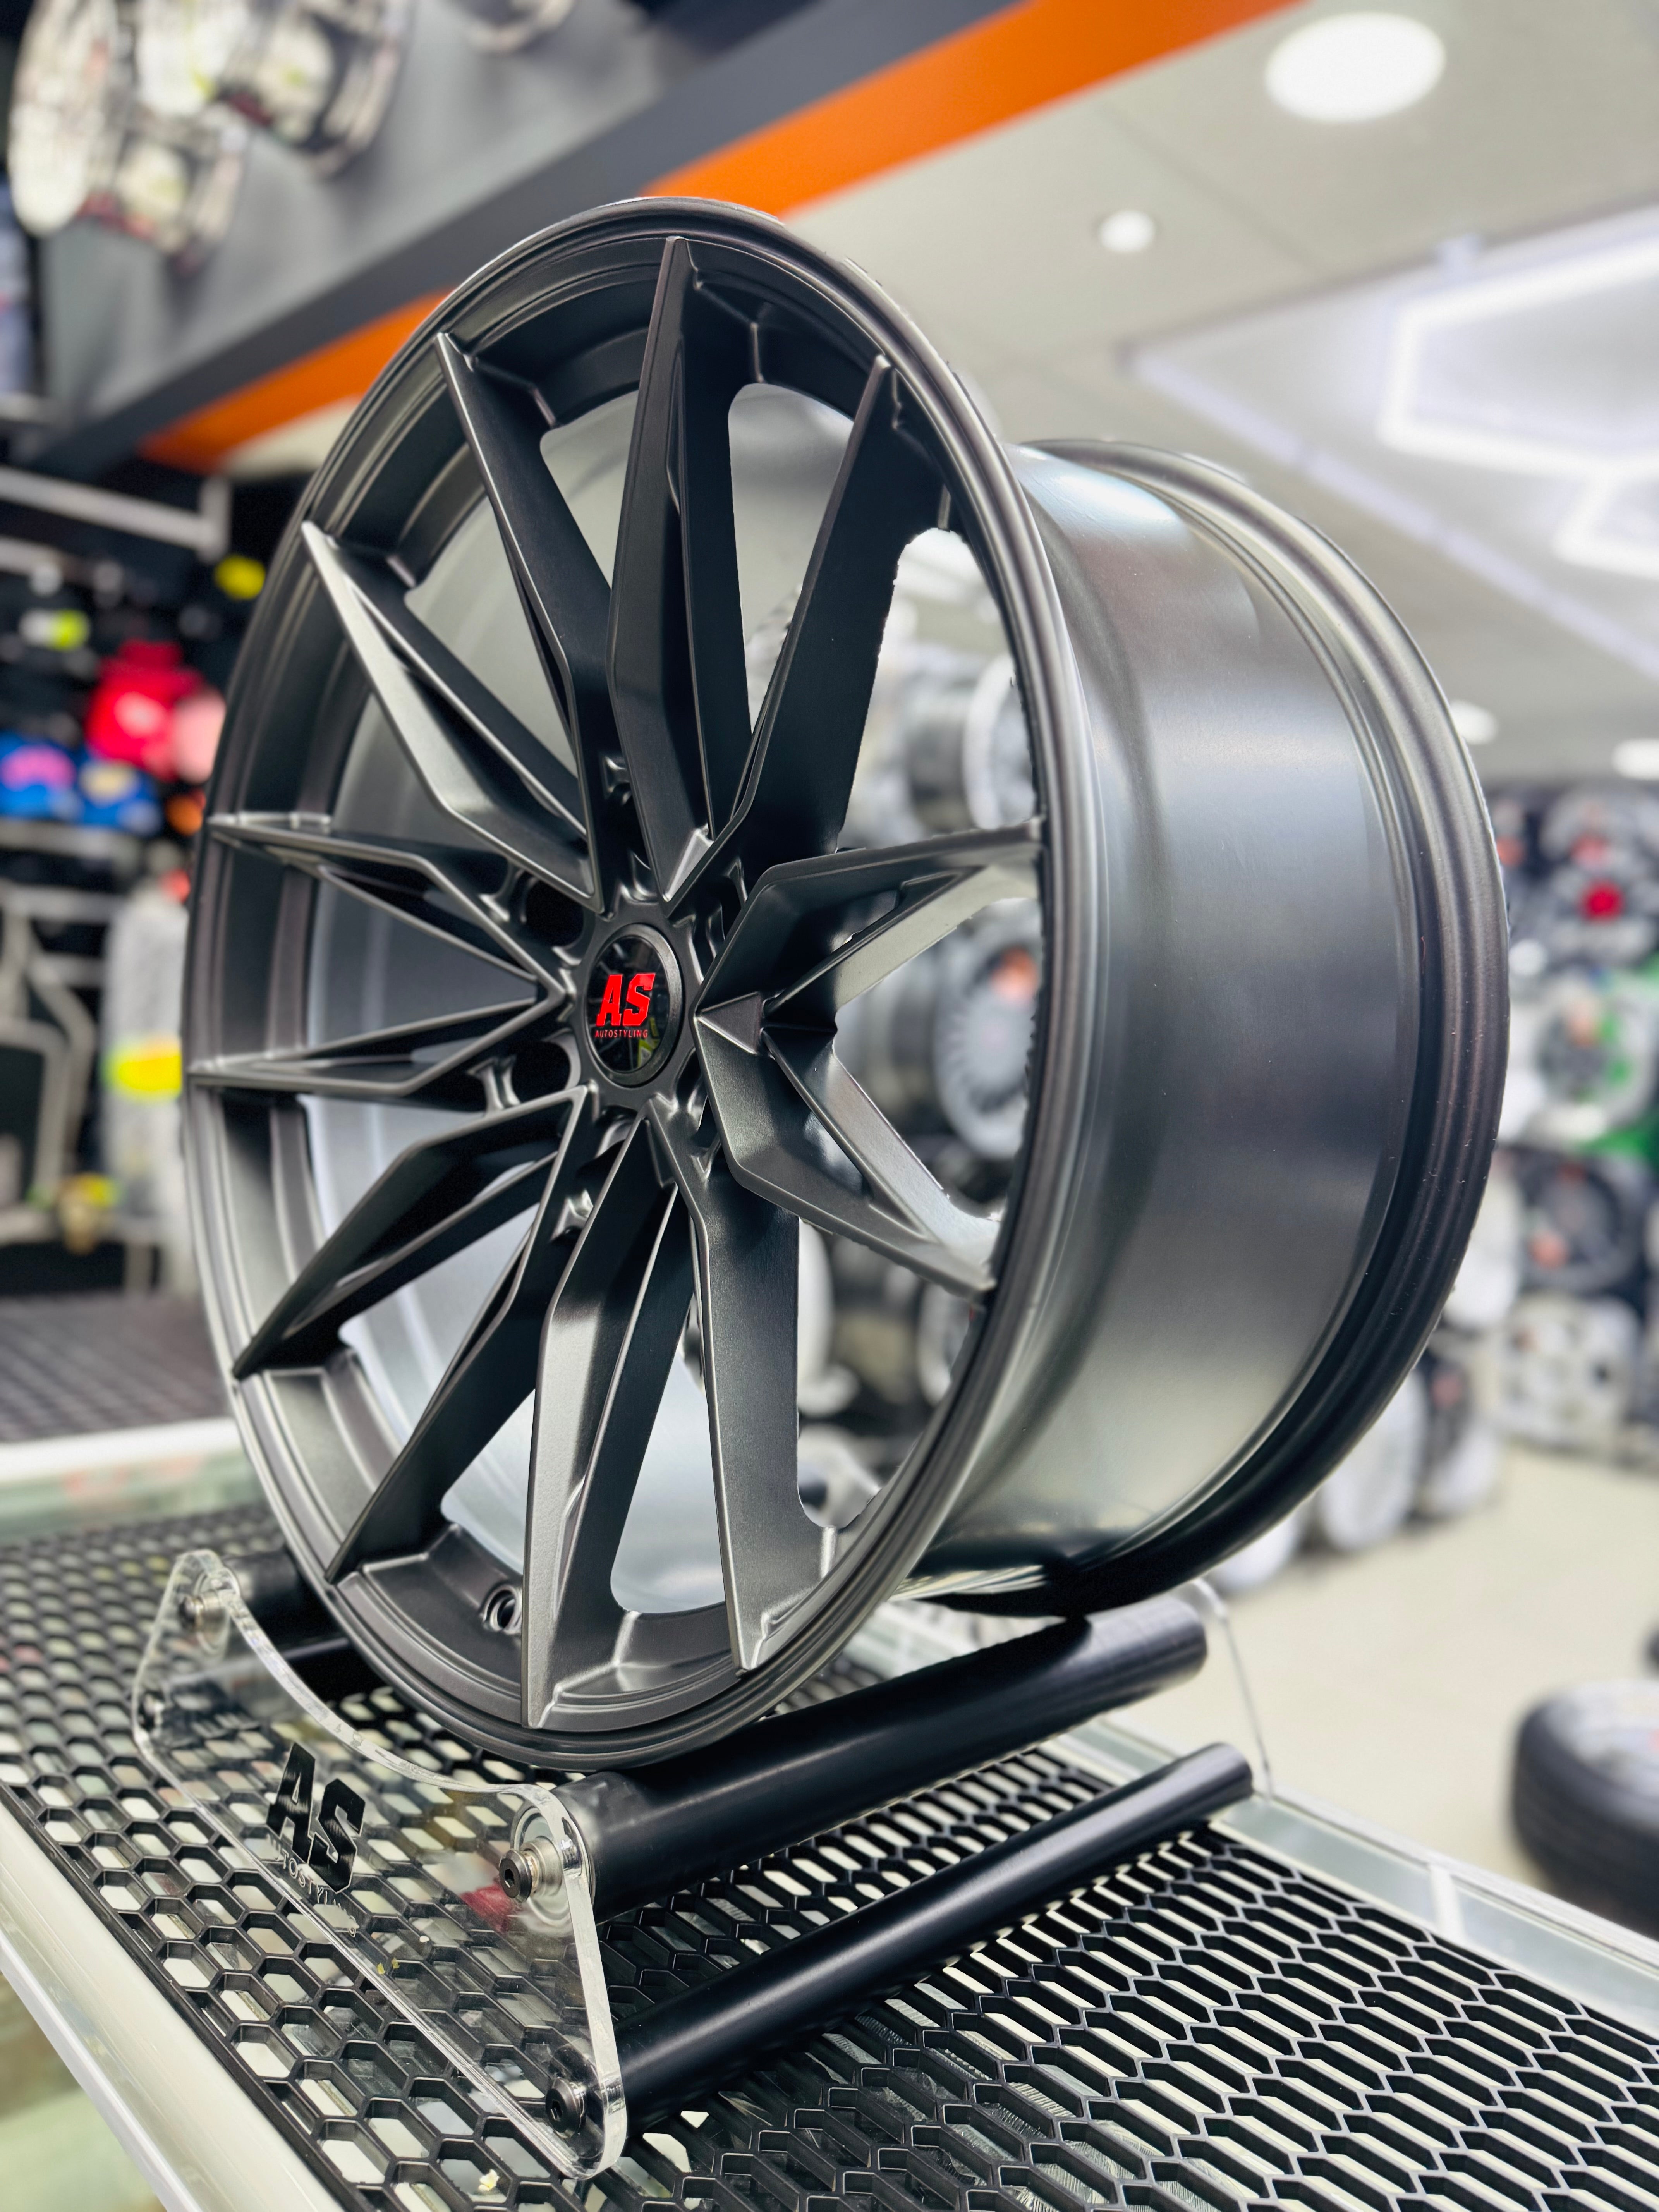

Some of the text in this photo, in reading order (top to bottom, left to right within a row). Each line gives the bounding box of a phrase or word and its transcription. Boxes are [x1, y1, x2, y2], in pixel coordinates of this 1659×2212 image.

[595, 1030, 648, 1038] AUTOSTYLING
[596, 973, 656, 1027] AS
[266, 1742, 366, 1893] AS
[264, 1832, 357, 1938] UTOSTYLG
